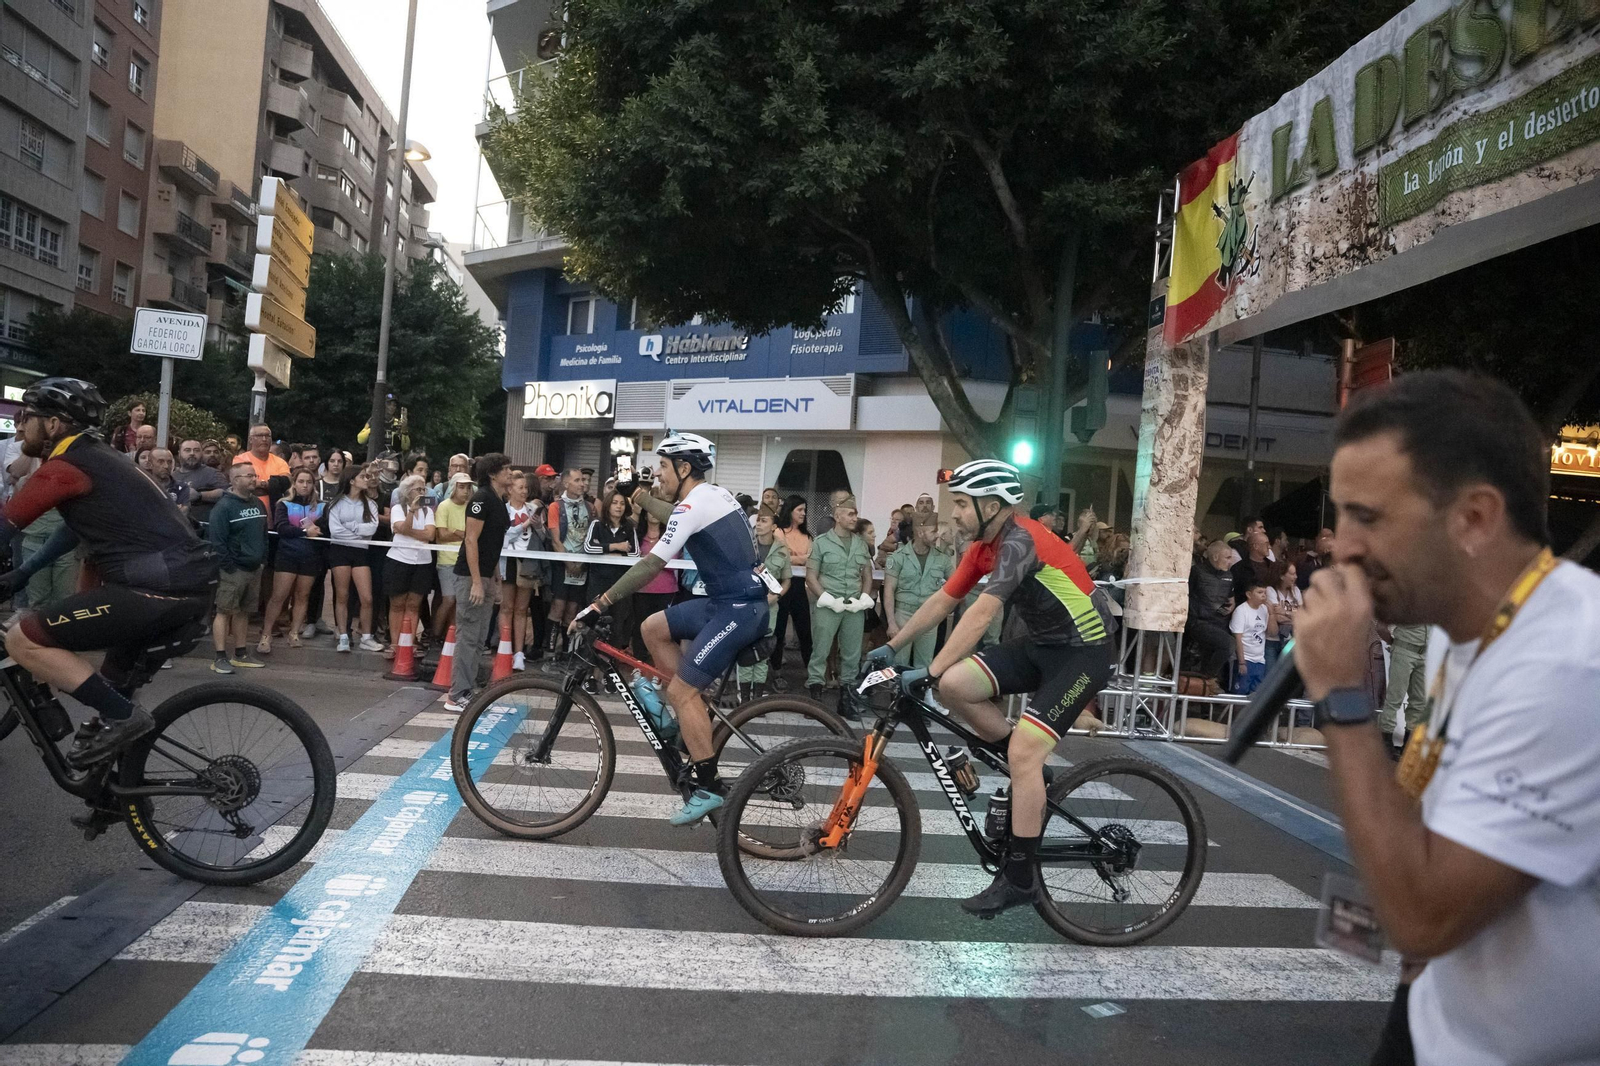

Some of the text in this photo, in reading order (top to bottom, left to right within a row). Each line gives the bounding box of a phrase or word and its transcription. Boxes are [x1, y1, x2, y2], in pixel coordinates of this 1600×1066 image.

[1270, 95, 1338, 202] LA
[1403, 85, 1600, 195] La Legión y el desierto
[156, 316, 200, 328] AVENIDA
[148, 326, 188, 341] FEDERICO
[665, 332, 749, 354] Háblame
[137, 337, 196, 354] GARCÍA LORCA
[575, 342, 608, 354] Psicología
[790, 342, 844, 355] Fisioterapia
[560, 354, 622, 367] Medicina de Familia
[665, 352, 747, 365] Centro Interdisciplinar
[524, 383, 613, 417] Phonika
[697, 397, 815, 414] VITALDENT
[46, 614, 71, 626] LA
[693, 620, 737, 665] KOMOMOLOS
[609, 672, 663, 750] ROCKRIDER
[920, 741, 979, 831] S-WORKS
[128, 804, 158, 849] MAXXIS
[366, 806, 429, 857] cajamar
[253, 900, 353, 992] cajamar
